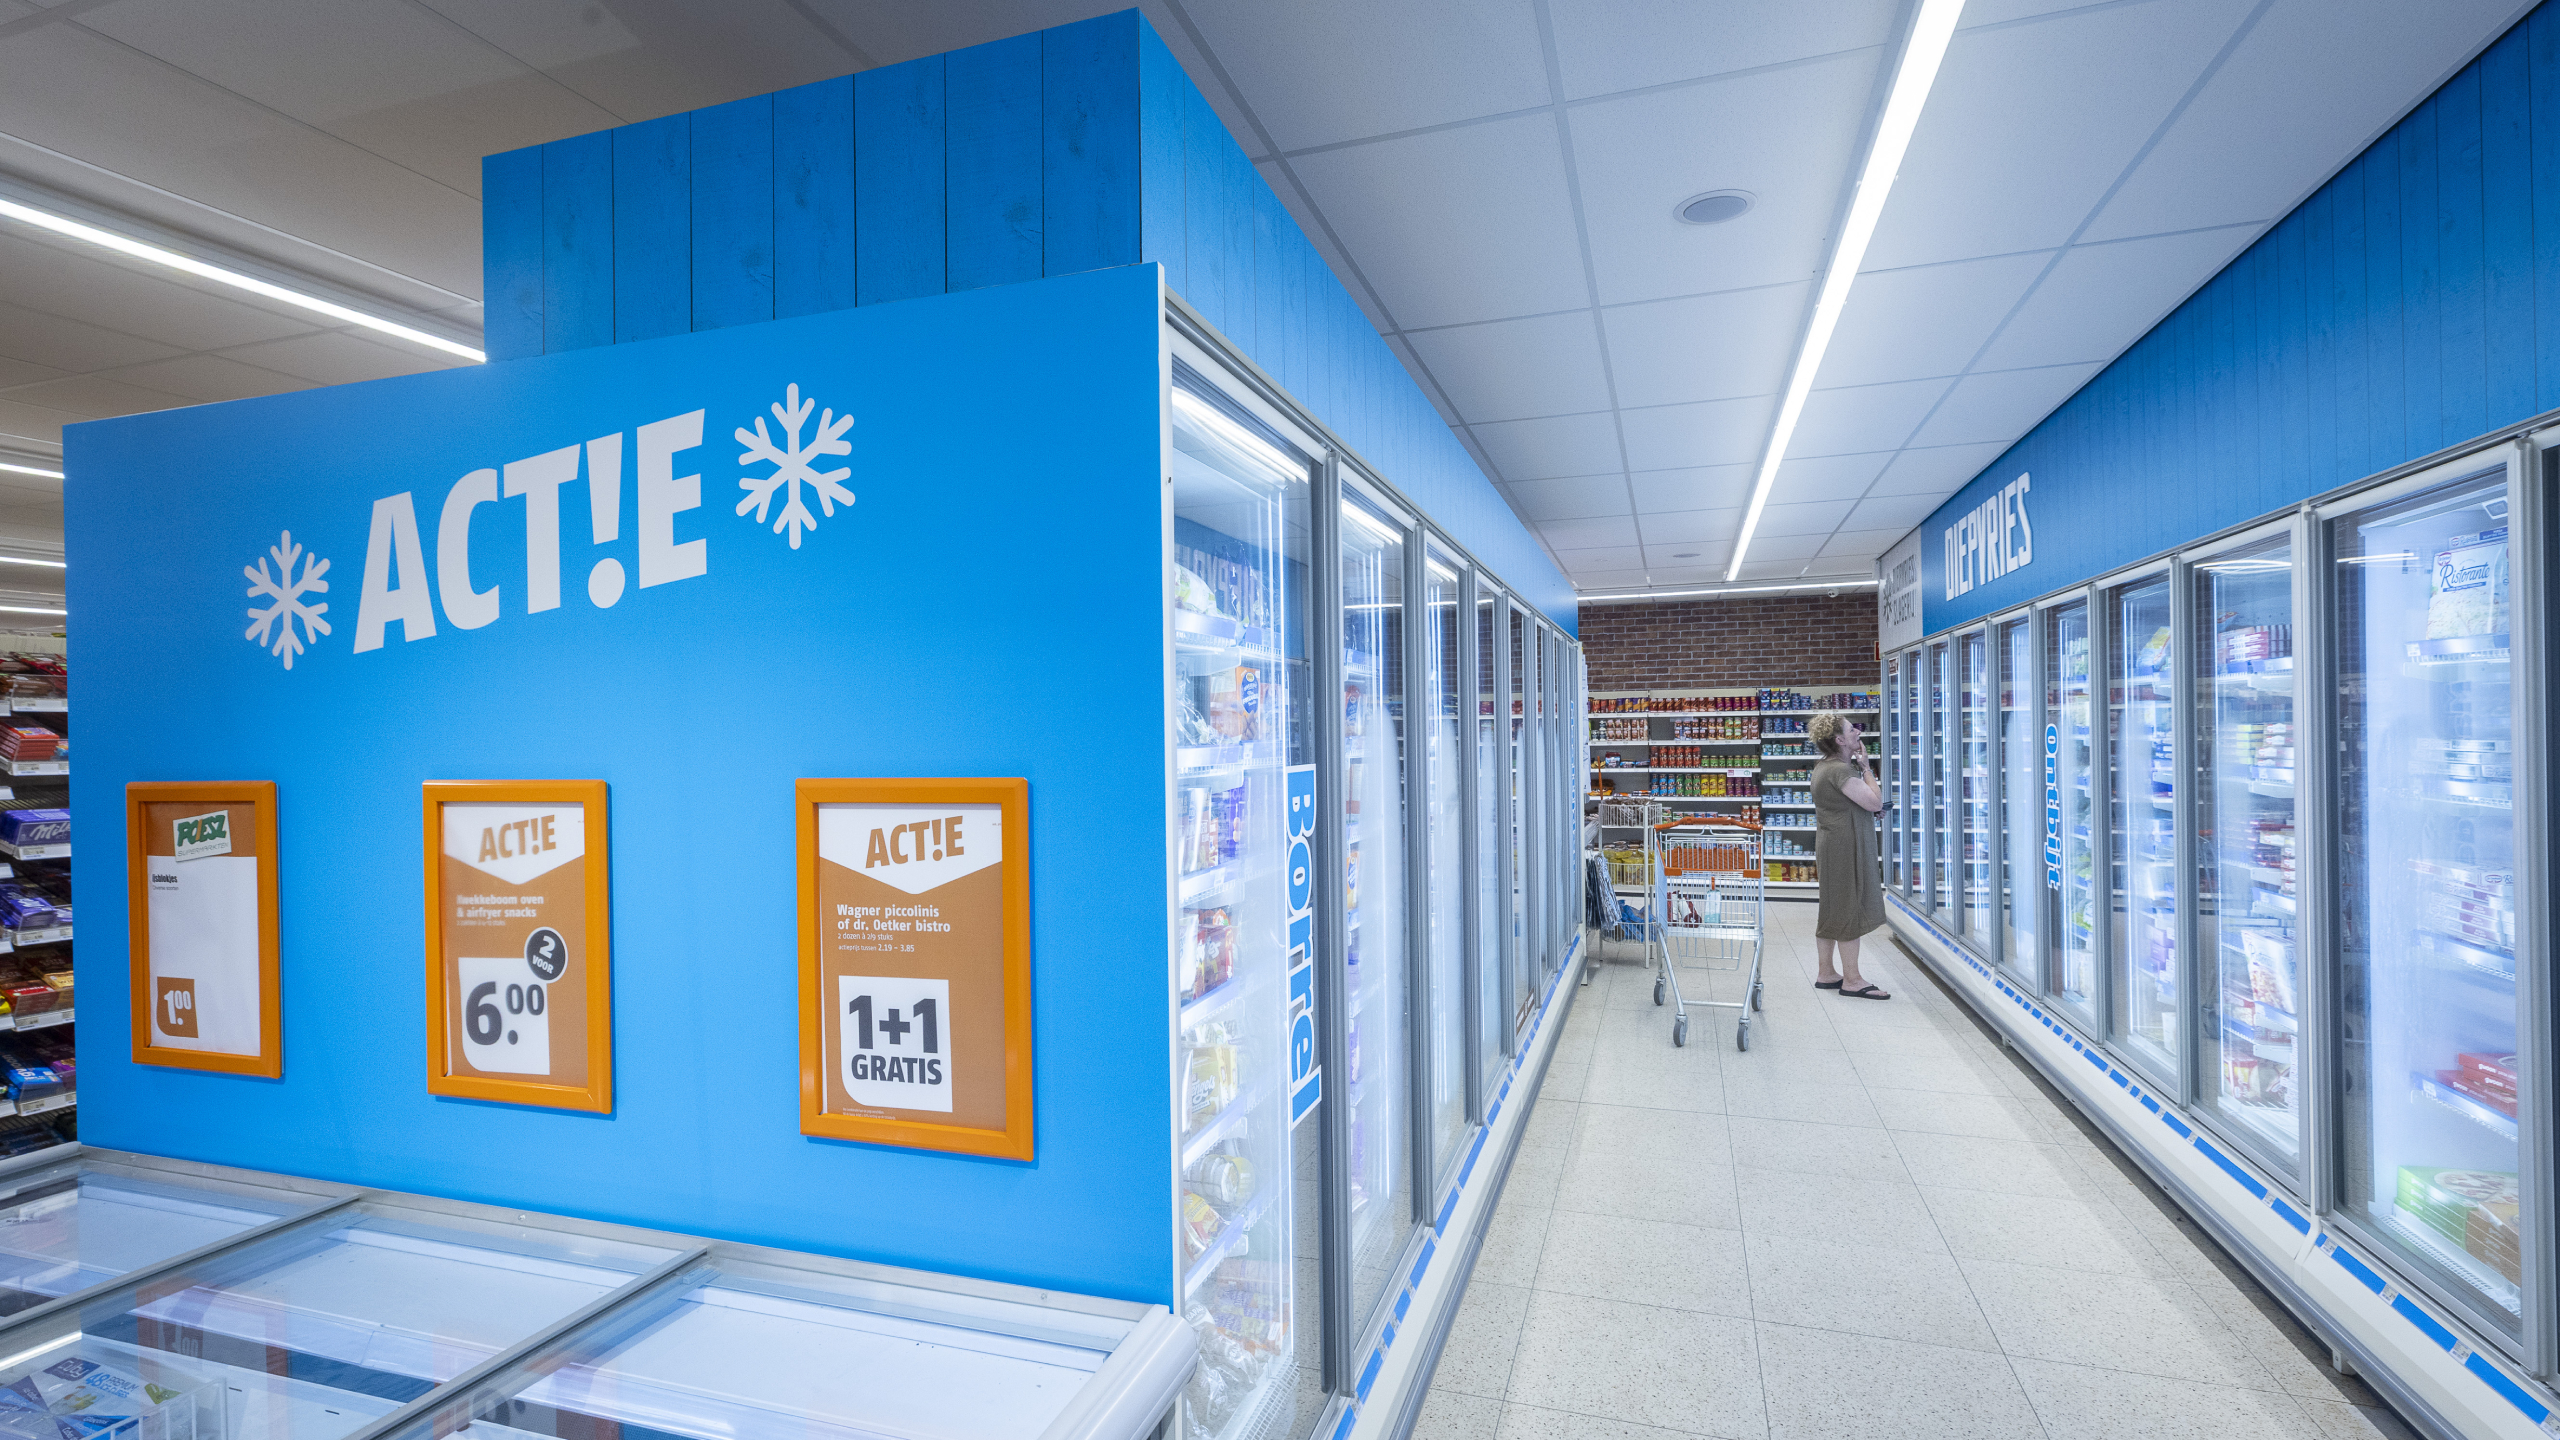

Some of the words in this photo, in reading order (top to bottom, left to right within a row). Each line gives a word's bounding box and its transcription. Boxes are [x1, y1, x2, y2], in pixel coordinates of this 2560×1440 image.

[353, 408, 707, 655] ACT!E
[1944, 471, 2033, 602] DIEPVRIES
[2440, 561, 2490, 588] Ristorante
[2044, 723, 2062, 892] Ontbijt
[177, 814, 227, 847] POIESZ
[478, 814, 557, 863] ACT!E
[865, 815, 965, 869] ACT!E
[177, 842, 228, 857] SUPERMARKTEN
[466, 907, 502, 920] airfryer
[504, 907, 537, 918] snacks
[520, 895, 544, 905] oven
[836, 904, 881, 918] Wagner
[884, 904, 940, 919] piccolinis
[837, 918, 851, 930] of
[853, 919, 869, 931] dr.
[873, 919, 912, 932] Oetker
[915, 919, 951, 933] bistro
[842, 932, 861, 940] dozen
[877, 933, 894, 941] stuks
[538, 935, 556, 960] 2
[877, 943, 893, 952] 2.19
[899, 943, 915, 953] 3.85
[1286, 763, 1322, 1131] Borrel
[531, 954, 555, 975] VOOR
[163, 989, 192, 1026] 1.00
[465, 981, 546, 1046] 6.00
[848, 994, 938, 1054] 1+1
[850, 1053, 943, 1085] GRATIS
[85, 1372, 111, 1387] 48
